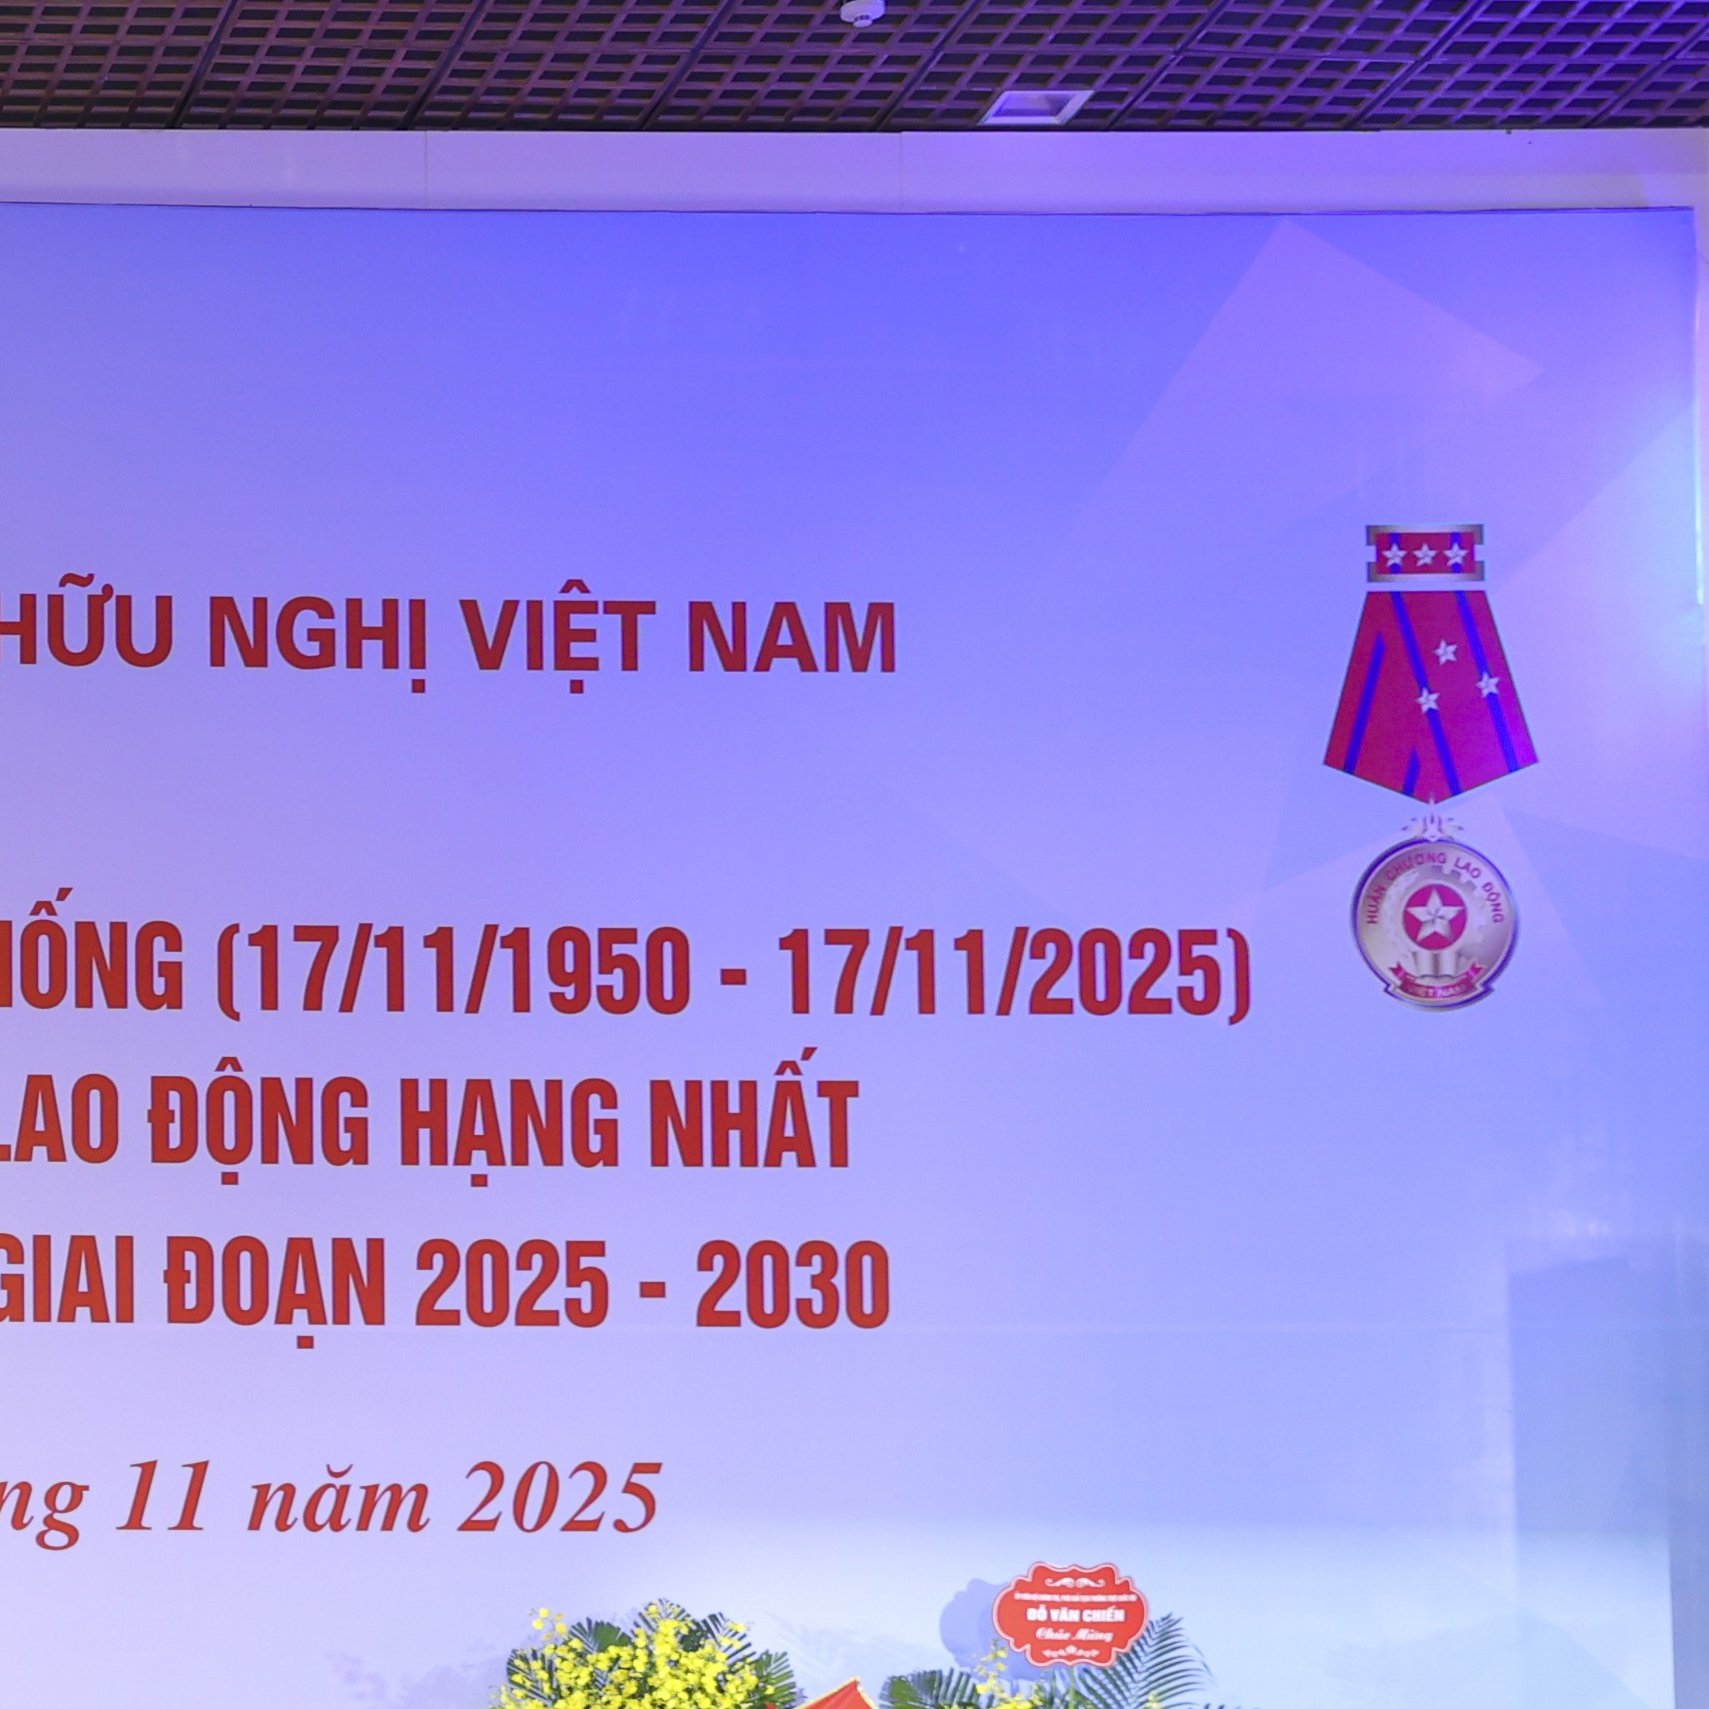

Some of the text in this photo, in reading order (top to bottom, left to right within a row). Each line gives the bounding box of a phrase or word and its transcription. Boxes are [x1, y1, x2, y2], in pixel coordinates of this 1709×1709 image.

[211, 596, 426, 693] NGHỊ
[461, 580, 655, 693] VIỆT
[691, 602, 894, 672] NAM
[1454, 857, 1481, 878] LAO
[218, 923, 690, 1021] (17/11/1950
[722, 969, 747, 985] -
[781, 926, 1249, 1024] 17/11/2025)
[147, 1056, 369, 1185] ĐỘNG
[401, 1078, 619, 1188] HẠNG
[650, 1047, 859, 1168] NHẤT
[163, 1234, 386, 1349] ĐOẠN
[416, 1238, 610, 1328] 2025
[640, 1281, 667, 1299] -
[697, 1239, 890, 1329] 2030
[118, 1460, 210, 1531] 11
[247, 1468, 429, 1533] năm
[458, 1460, 662, 1534] 2025
[1026, 1604, 1126, 1622] ĐỖ VĂN CHIẾN
[1035, 1627, 1114, 1642] Chúc Mừng
